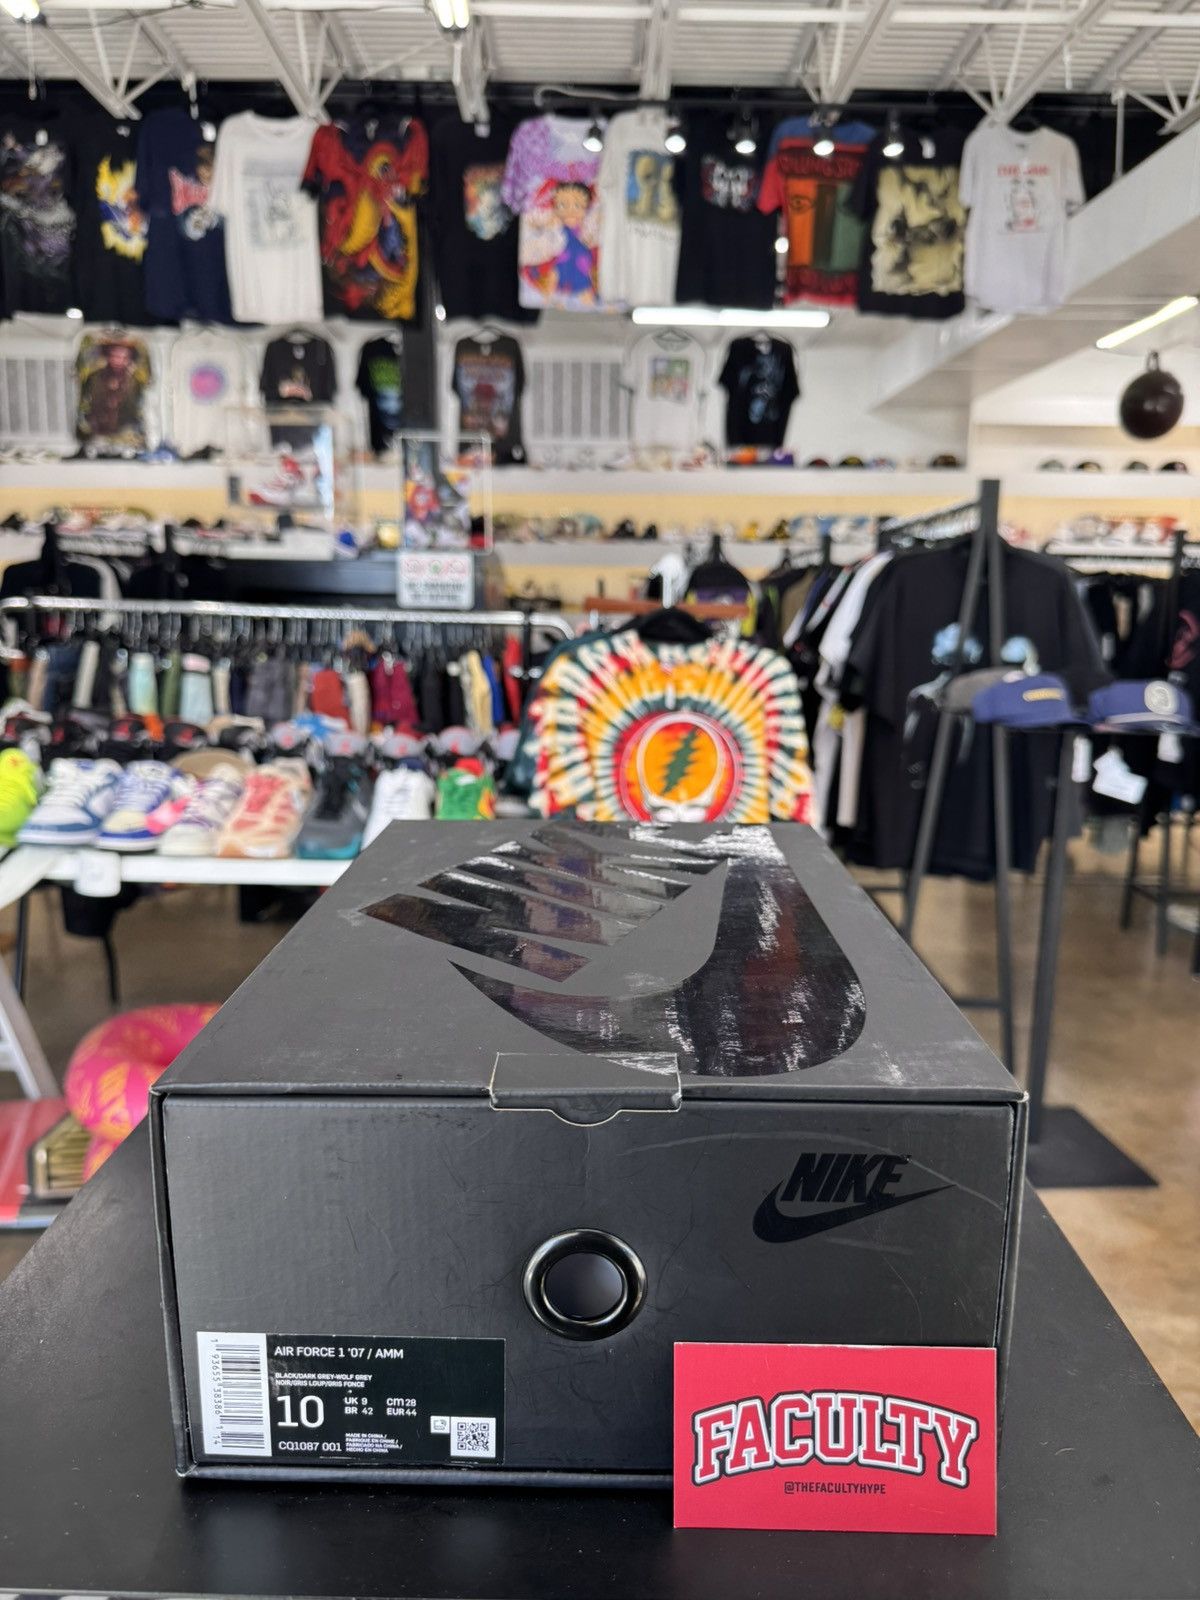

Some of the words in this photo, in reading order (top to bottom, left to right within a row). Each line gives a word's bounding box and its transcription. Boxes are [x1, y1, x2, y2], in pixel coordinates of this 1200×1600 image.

[780, 1153, 912, 1202] NIKE
[274, 1346, 294, 1357] AIR
[296, 1346, 335, 1358] FORCE
[338, 1347, 345, 1358] 1
[367, 1348, 372, 1360] /
[375, 1348, 404, 1359] AMM
[212, 1353, 220, 1382] 93655
[274, 1372, 316, 1380] BLACK/DARK
[213, 1387, 222, 1415] 38386
[344, 1397, 358, 1405] UK
[361, 1397, 368, 1406] 9
[405, 1398, 417, 1407] 28
[276, 1395, 325, 1428] 10
[344, 1407, 358, 1415] BR
[361, 1407, 374, 1415] 42
[387, 1408, 405, 1416] EUR
[405, 1408, 417, 1416] 44
[278, 1440, 319, 1451] CQ1087
[322, 1442, 342, 1452] 001
[691, 1389, 980, 1489] FACULTY
[784, 1481, 886, 1495] @THEFACULTYHYPE
